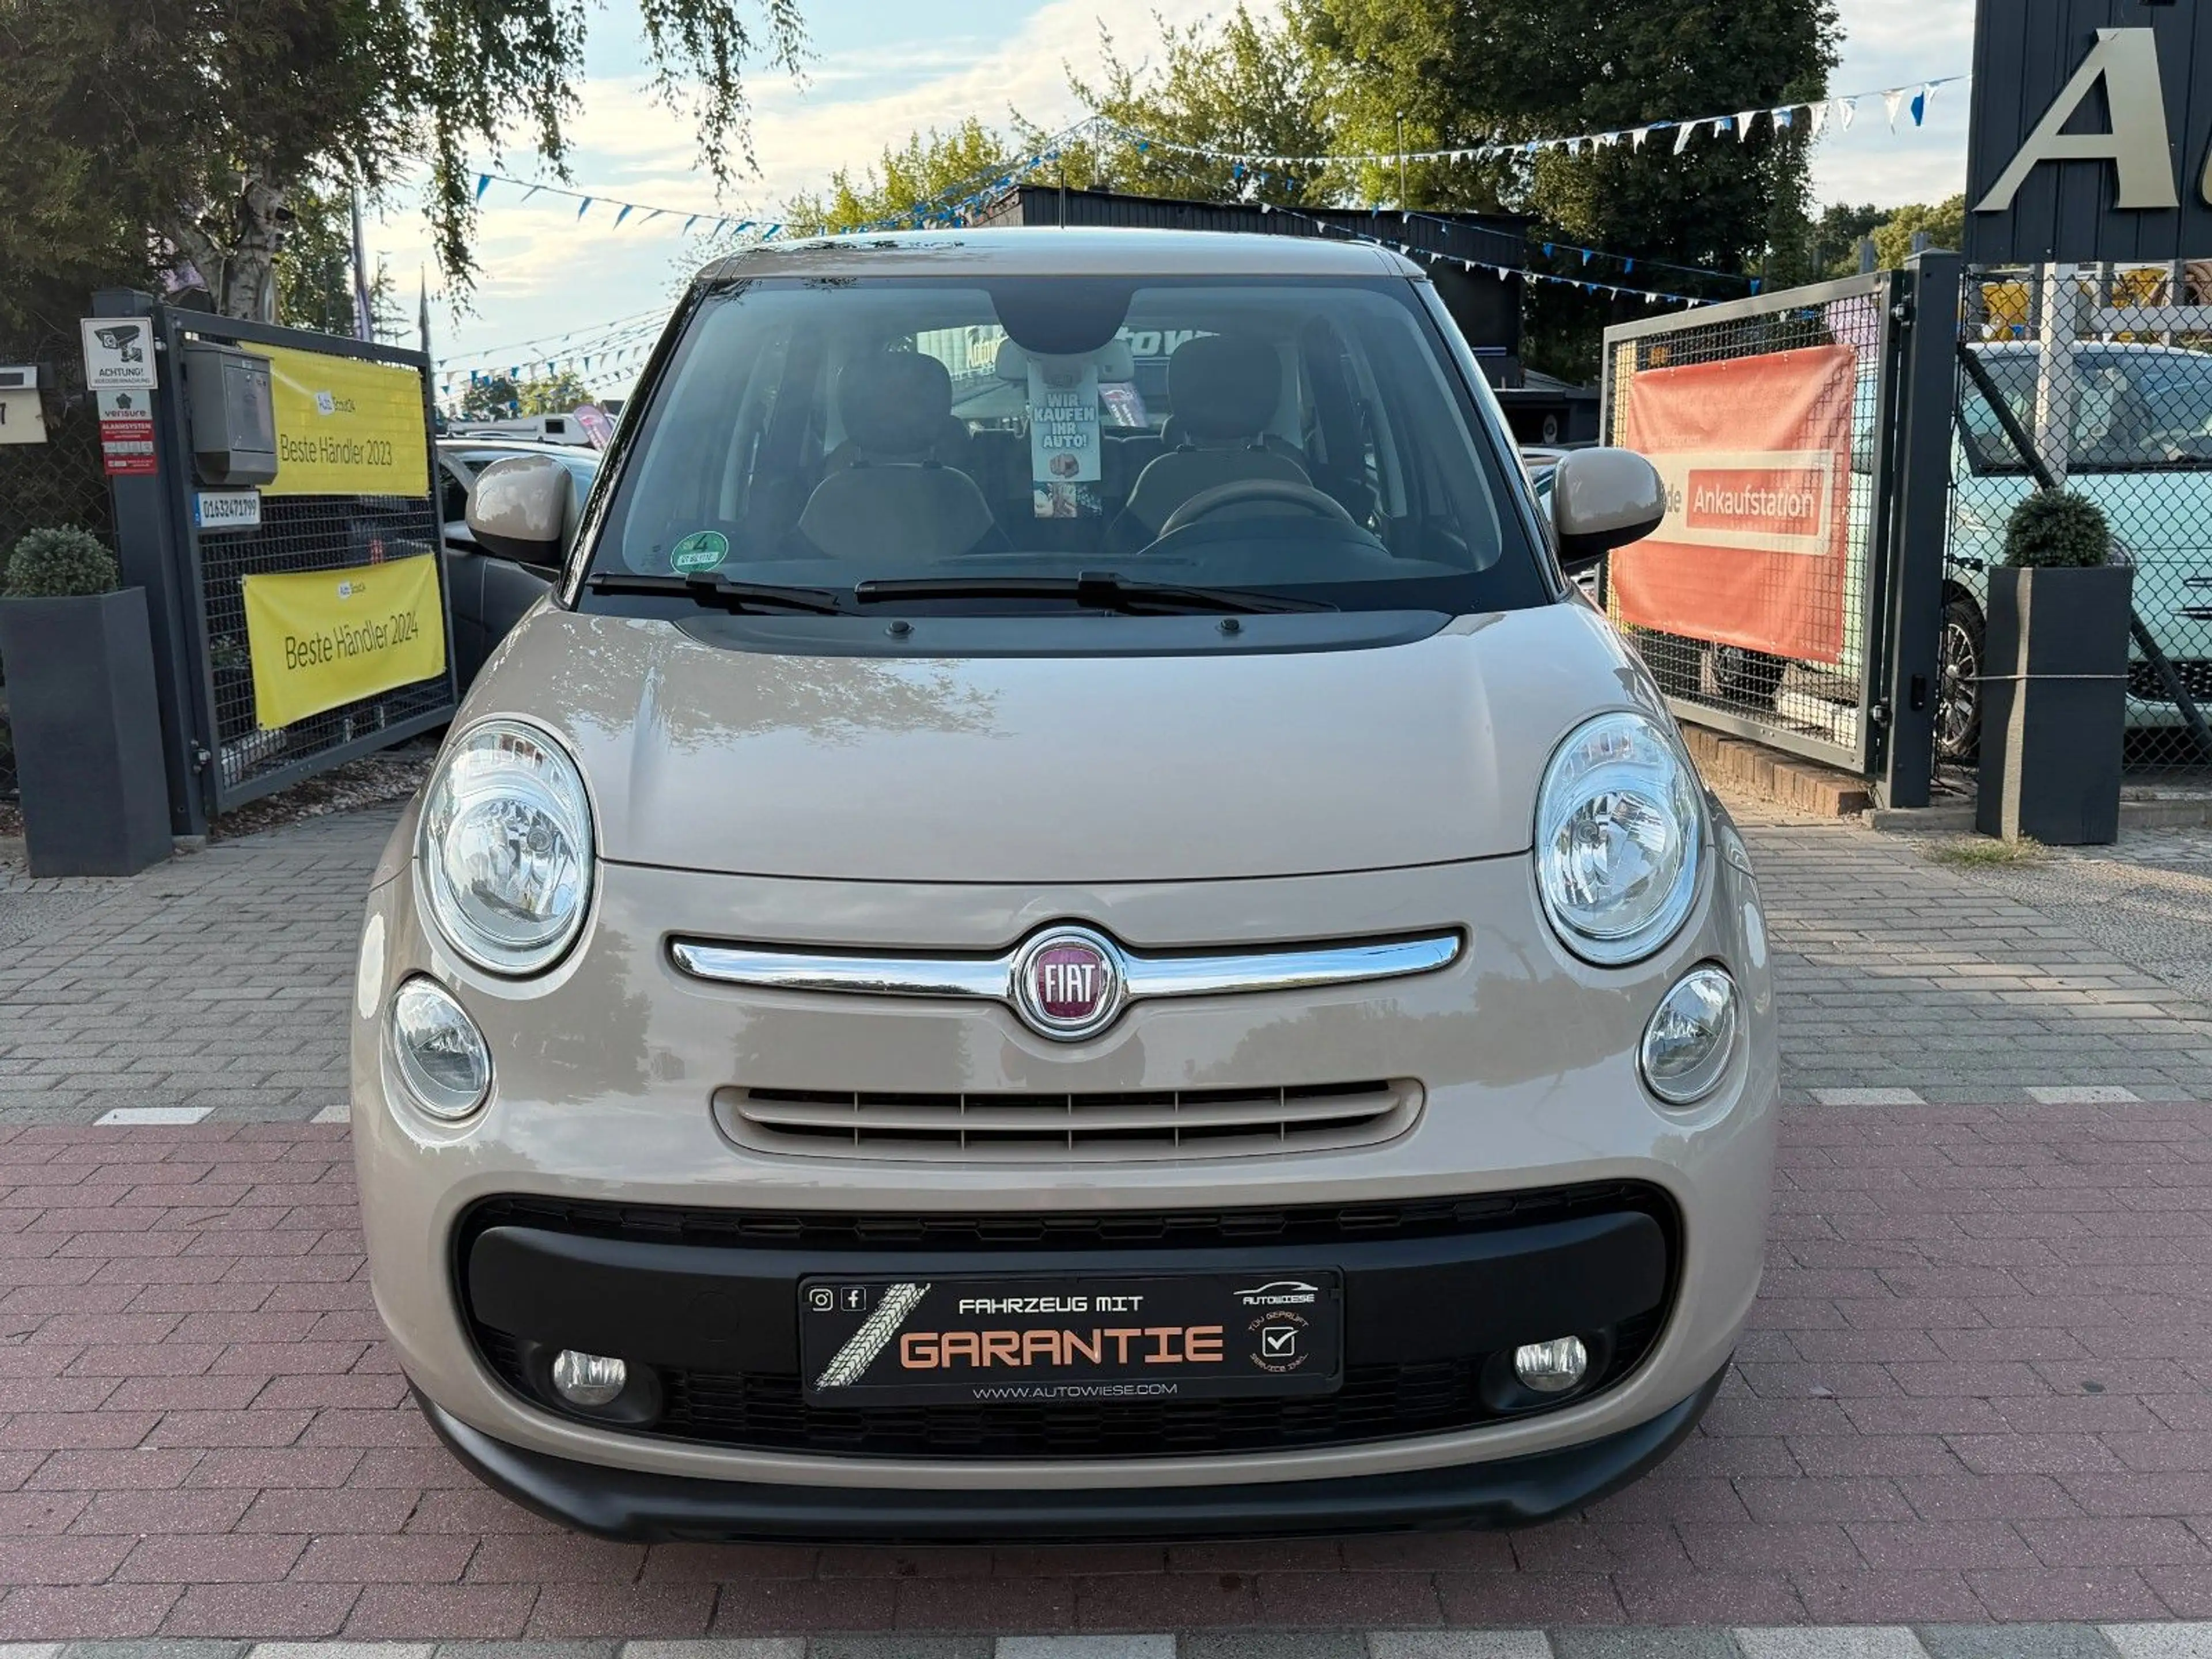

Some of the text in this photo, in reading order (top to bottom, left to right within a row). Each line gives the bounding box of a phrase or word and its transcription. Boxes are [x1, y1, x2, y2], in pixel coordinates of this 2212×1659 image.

[1972, 28, 2212, 211] A
[99, 368, 143, 377] ACHTUNG!
[1047, 393, 1080, 407] WIR
[104, 410, 147, 418] verisure
[1033, 407, 1095, 422] KAUFEN
[1052, 422, 1077, 435] IHR
[280, 433, 393, 466] Beste Händler 2023
[1043, 434, 1088, 448] AUTO!
[1693, 483, 1815, 518] Ankaufstation
[693, 533, 708, 552] 4
[285, 611, 419, 670] Beste Händler 2024
[1044, 964, 1096, 1003] FIAT
[959, 1296, 1144, 1315] FAHRZEUG MIT
[1242, 1294, 1315, 1305] AUTOWIESE
[900, 1325, 1224, 1369] GARANTIE
[973, 1383, 1178, 1400] WWW.AUTOWIESE.COM
